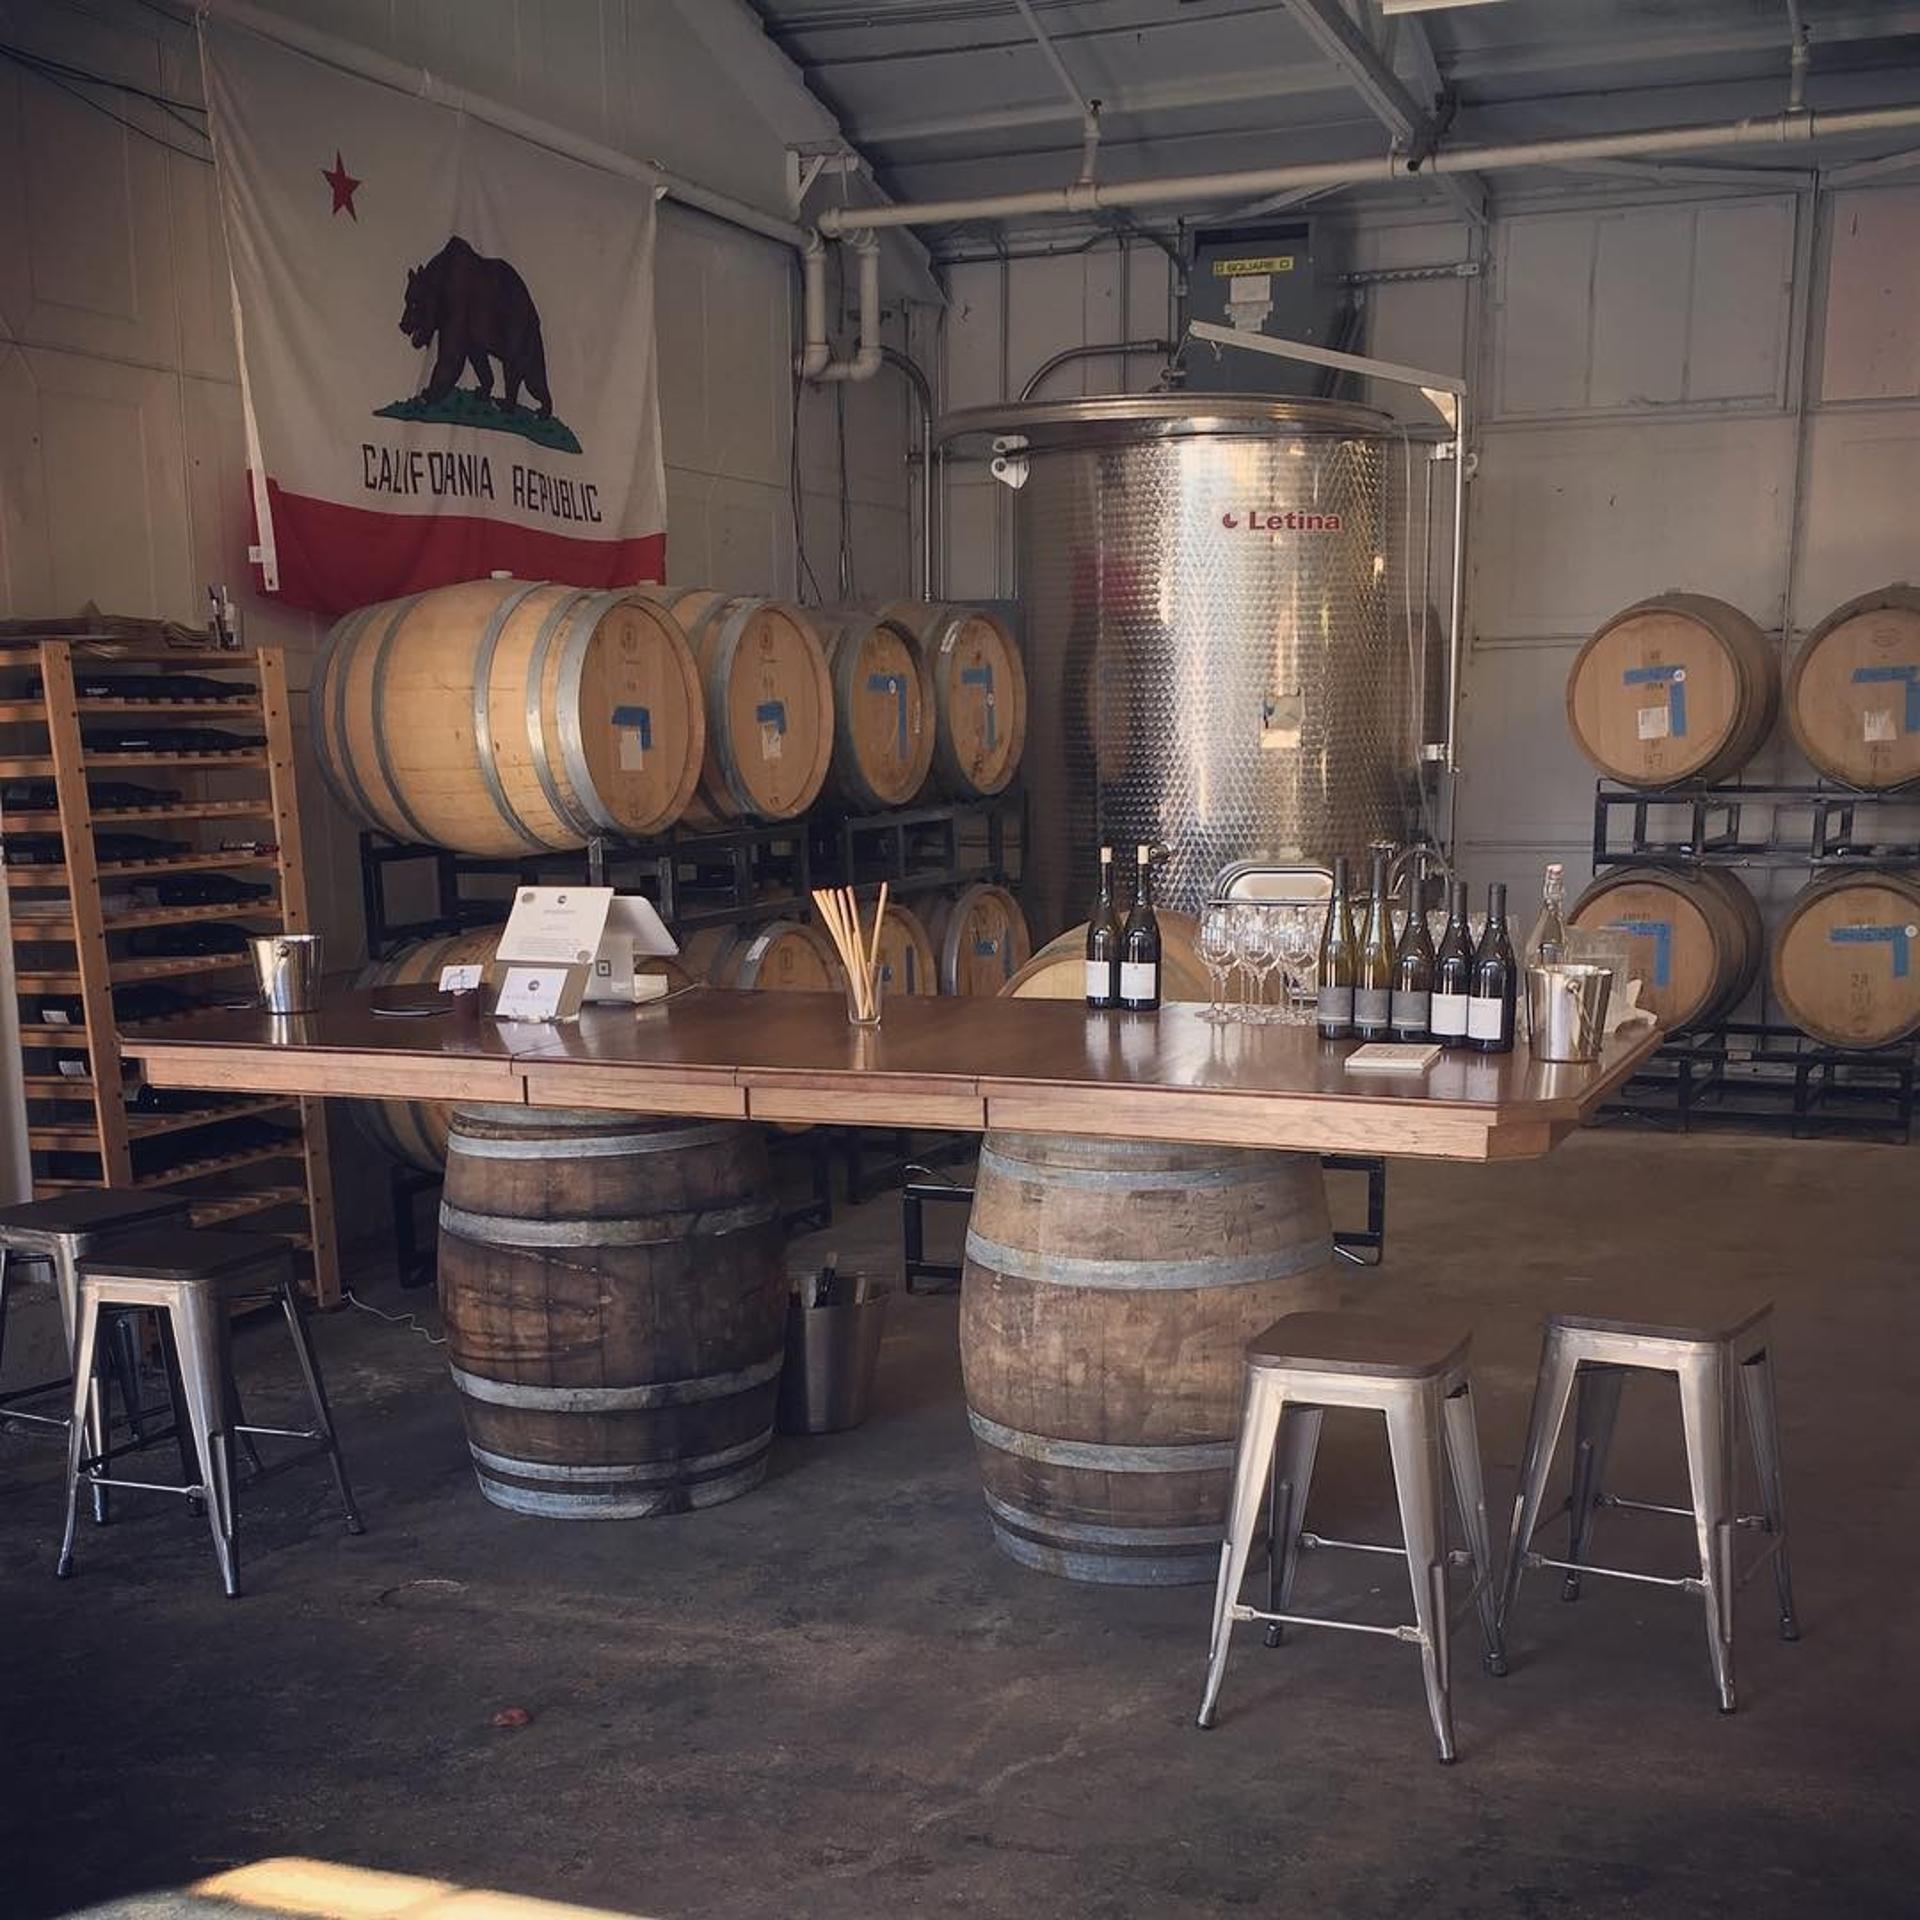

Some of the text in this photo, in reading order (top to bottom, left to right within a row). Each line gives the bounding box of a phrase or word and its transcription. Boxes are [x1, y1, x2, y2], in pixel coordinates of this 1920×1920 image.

[362, 443, 602, 523] CALIFORNIA REPUBLIC
[1249, 511, 1340, 531] Letina
